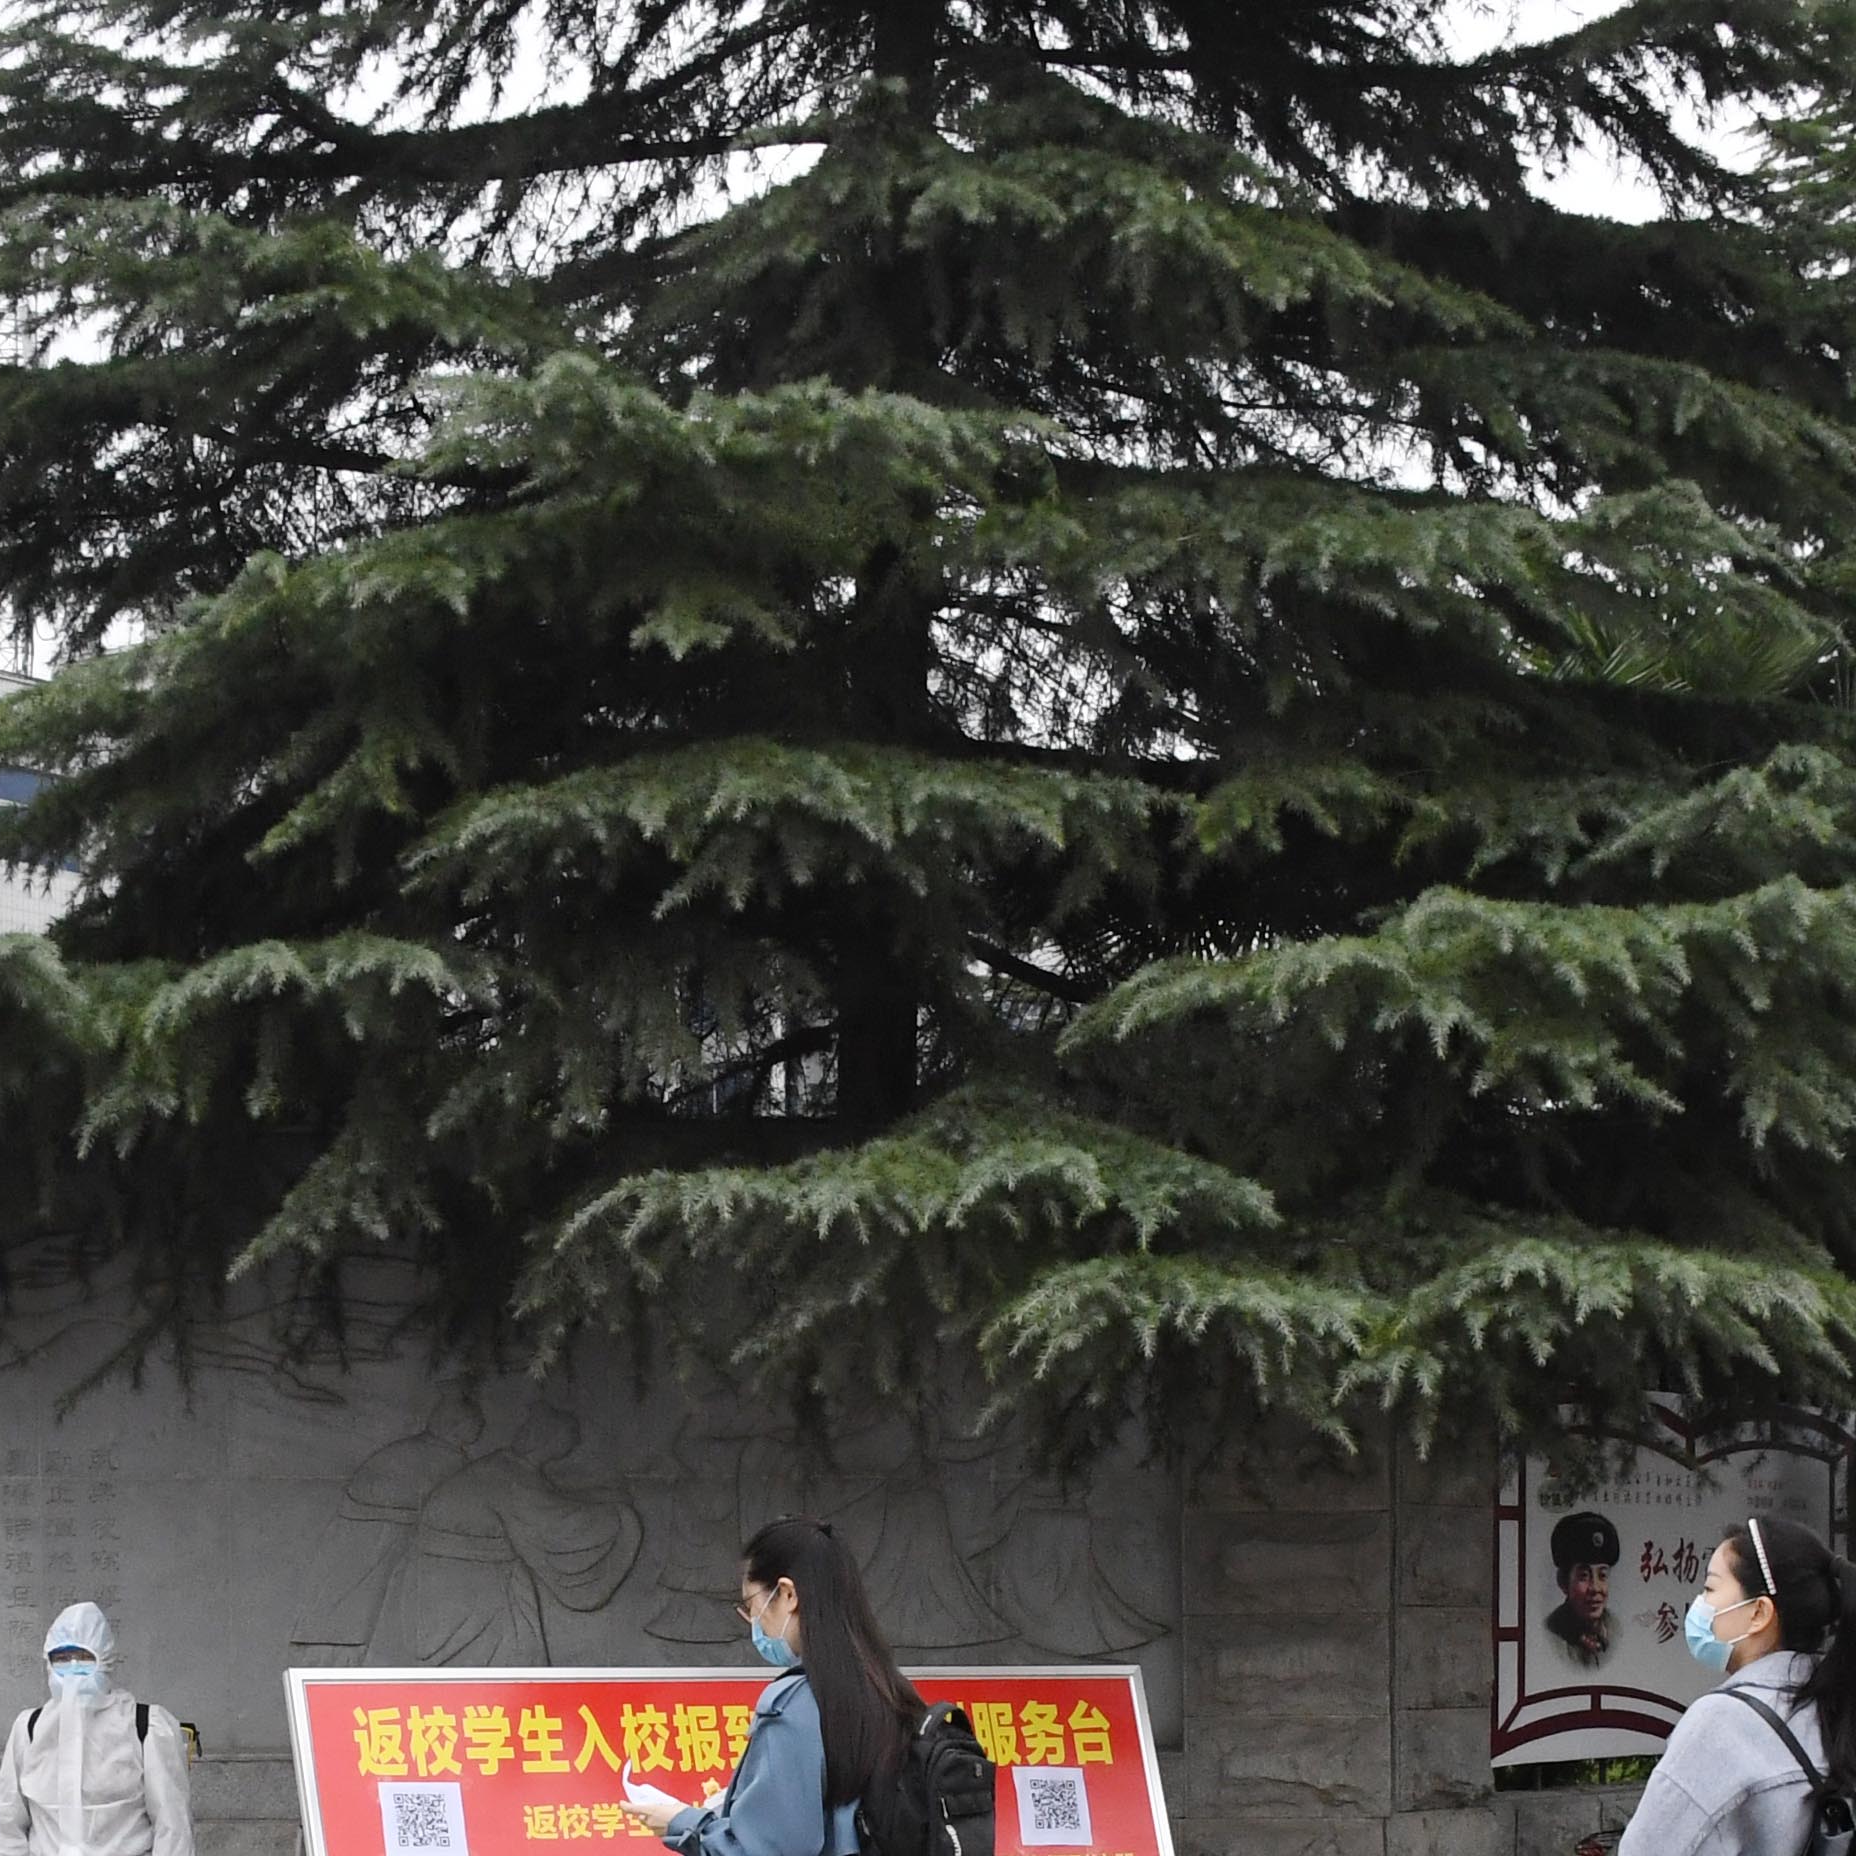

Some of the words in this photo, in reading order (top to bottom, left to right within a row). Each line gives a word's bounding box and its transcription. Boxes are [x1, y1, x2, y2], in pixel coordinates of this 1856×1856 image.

[1640, 1537, 1716, 1584] 弘扬
[1655, 1602, 1690, 1644] 参
[353, 1704, 755, 1777] 返校学生入校报到
[944, 1700, 1114, 1767] 服务台
